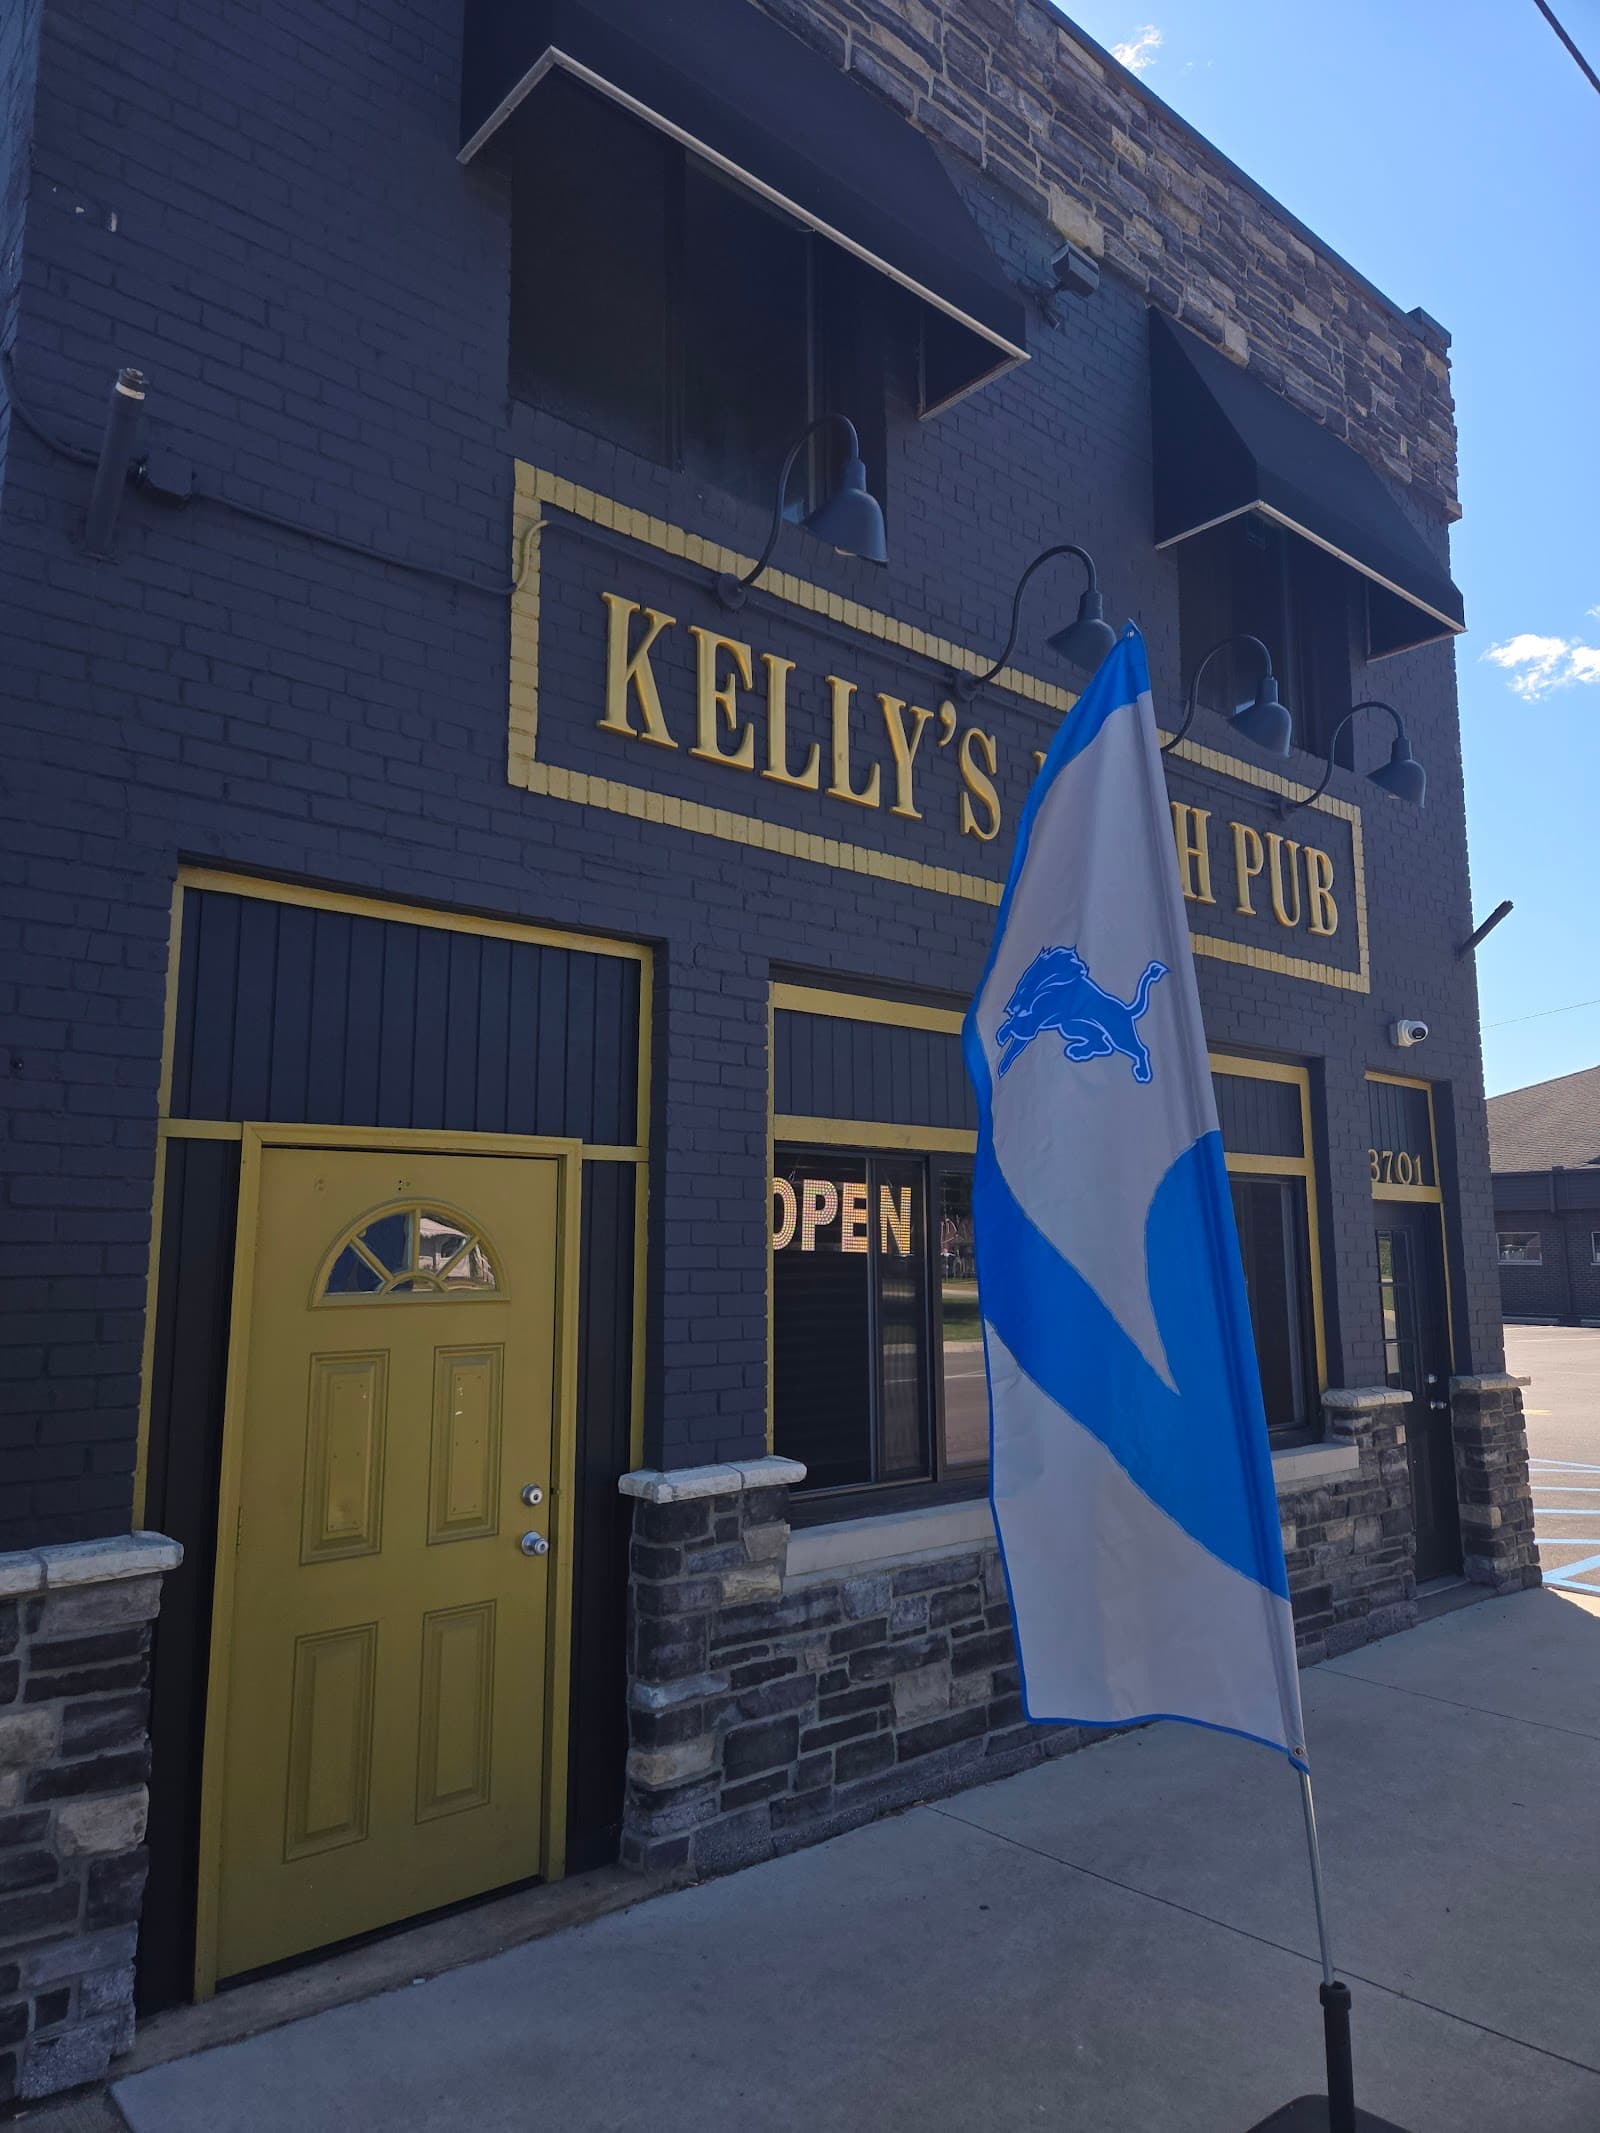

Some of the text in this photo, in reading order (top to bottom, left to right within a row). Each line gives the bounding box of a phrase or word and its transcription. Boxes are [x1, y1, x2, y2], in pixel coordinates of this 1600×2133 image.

[597, 592, 1001, 840] KELLY'S
[1230, 822, 1338, 936] PUB
[1368, 1149, 1423, 1185] 3701
[772, 1177, 911, 1254] OPEN
